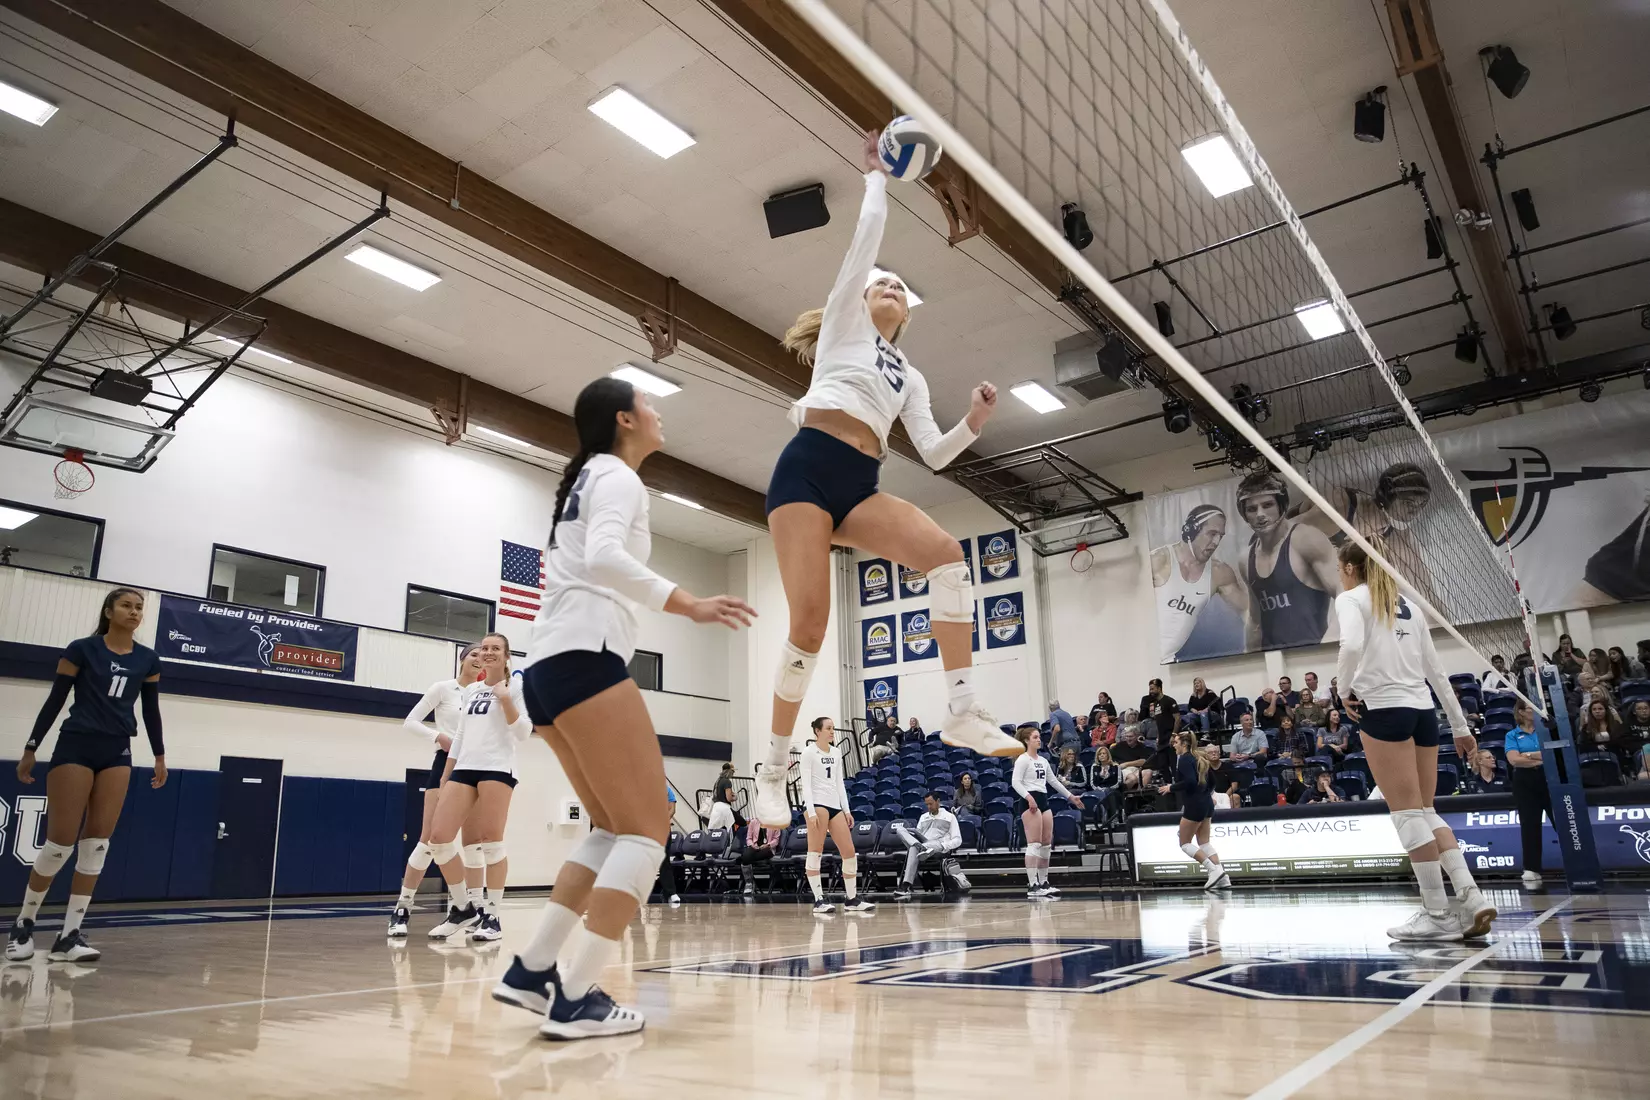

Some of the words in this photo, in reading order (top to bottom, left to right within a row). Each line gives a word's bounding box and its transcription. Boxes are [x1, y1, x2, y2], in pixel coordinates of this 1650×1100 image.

[867, 577, 886, 586] RMAC
[1167, 595, 1196, 616] cbu
[199, 604, 244, 618] Fueled
[247, 612, 264, 623] by
[268, 615, 323, 631] Provider.
[869, 636, 889, 645] RMAC
[190, 645, 206, 654] CBU
[277, 651, 337, 665] provider
[276, 666, 300, 674] contract
[108, 675, 128, 698] 11
[468, 700, 491, 715] 10
[825, 767, 832, 779] 1
[1035, 769, 1046, 779] 12
[1563, 795, 1576, 819] sports
[1282, 819, 1362, 835] SAVAGE
[1569, 820, 1582, 850] imports
[1488, 855, 1515, 867] CBU
